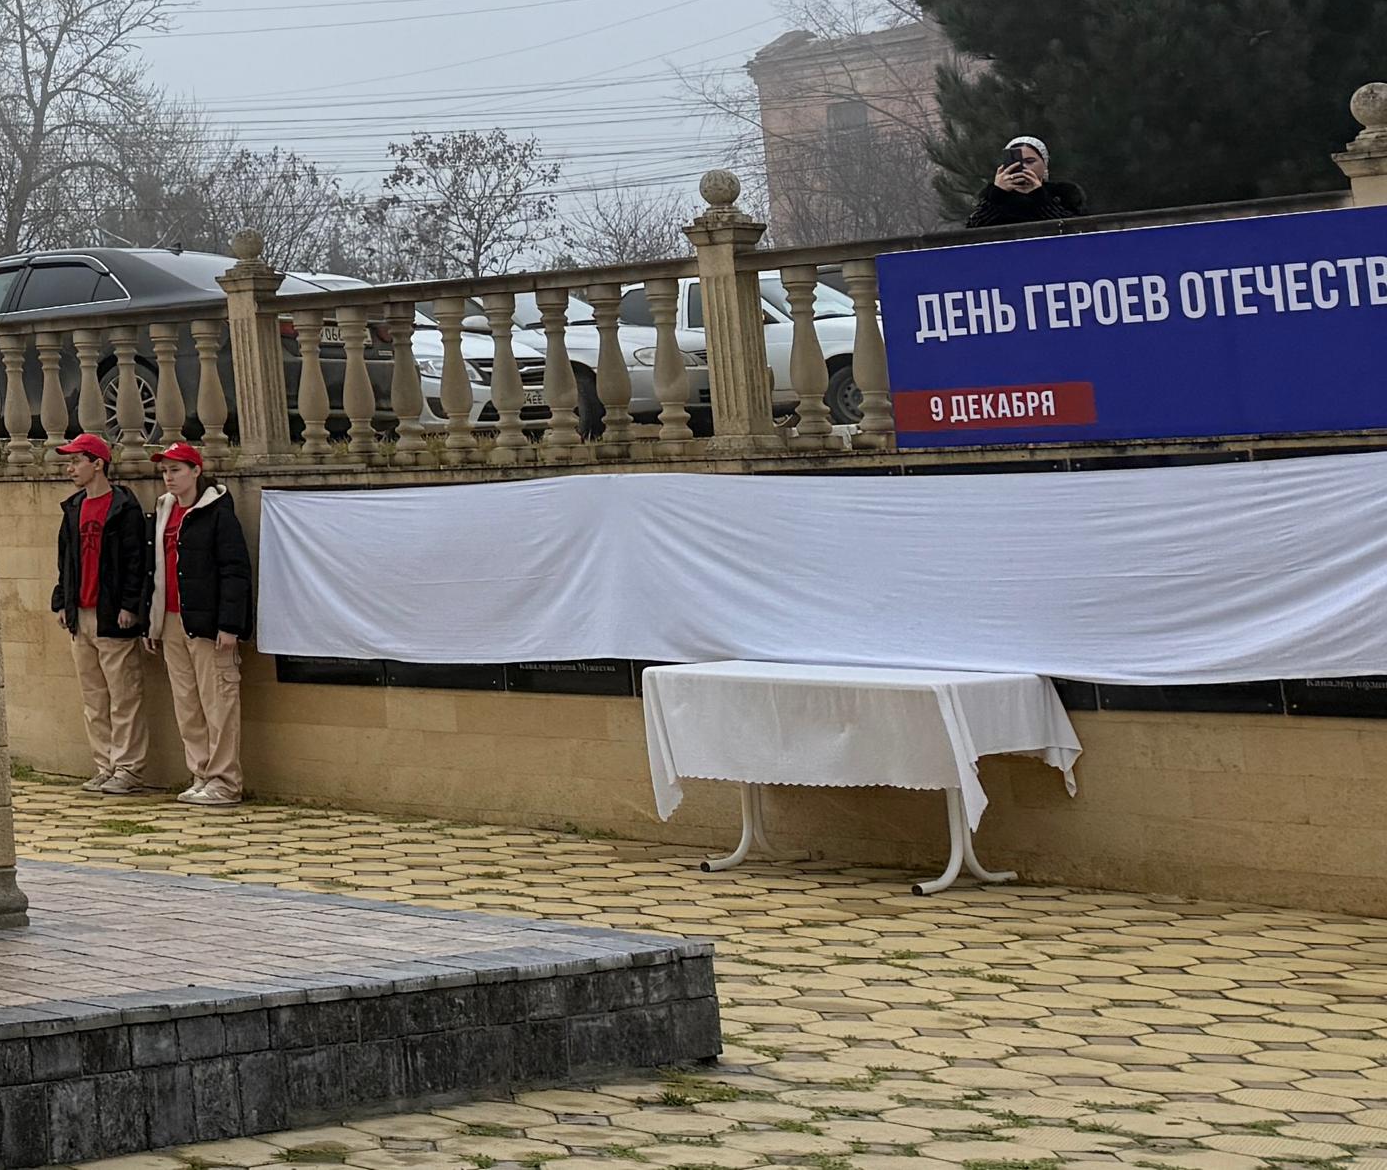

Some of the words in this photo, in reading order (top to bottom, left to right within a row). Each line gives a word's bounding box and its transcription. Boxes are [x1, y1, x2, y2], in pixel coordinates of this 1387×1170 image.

[916, 288, 1016, 343] ДЕНЬ
[1024, 274, 1170, 330] ГЕРОЕВ
[1179, 255, 1387, 319] ОТЕЧЕСТВ
[930, 396, 944, 422] 9
[950, 390, 1056, 423] ДЕКАБРЯ
